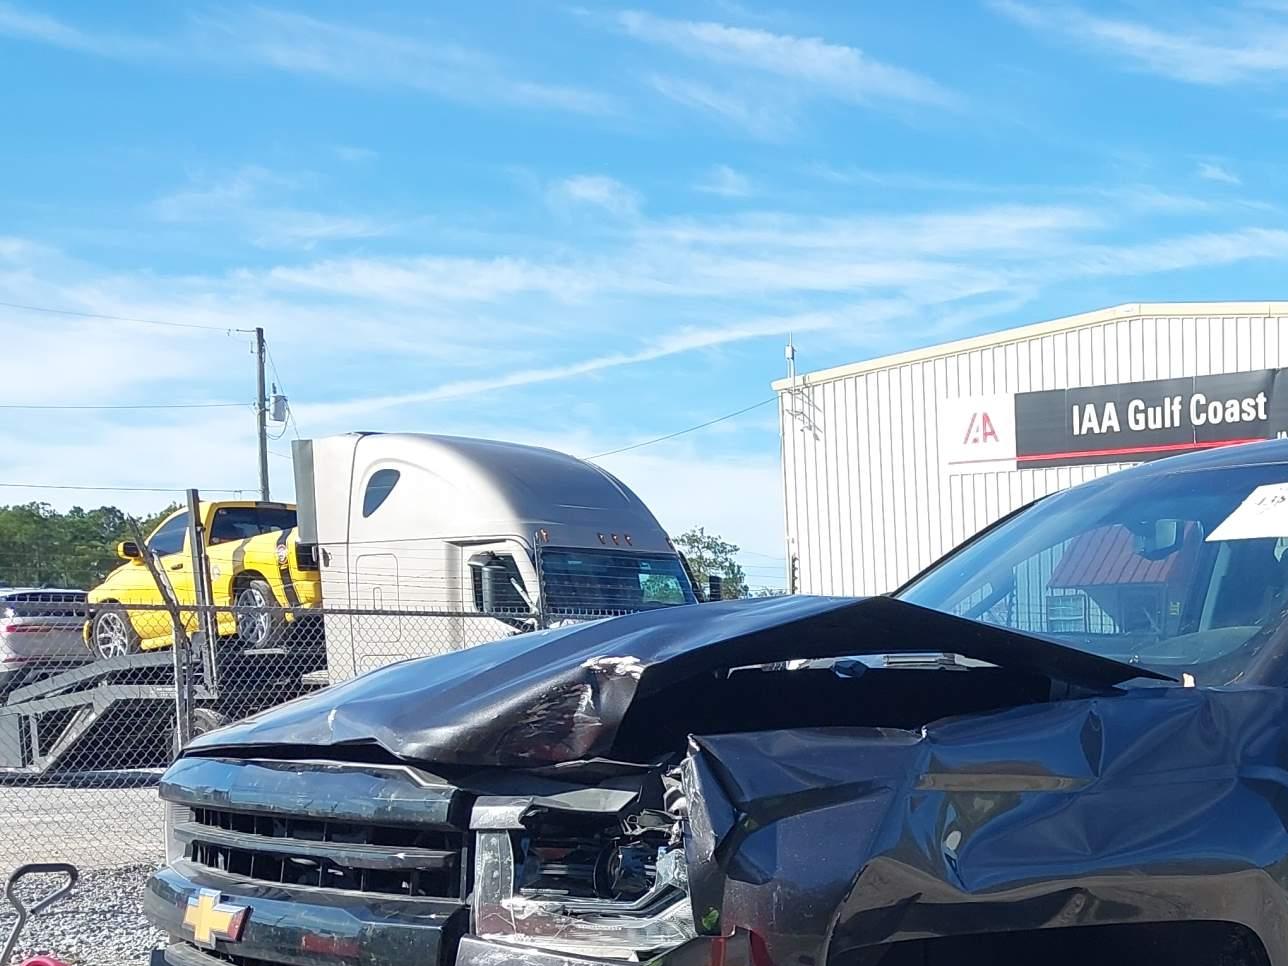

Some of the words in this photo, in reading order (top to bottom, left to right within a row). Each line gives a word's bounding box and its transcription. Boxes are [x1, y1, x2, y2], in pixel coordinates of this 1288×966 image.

[1071, 402, 1120, 436] IAA
[1127, 394, 1182, 432] Gulf
[1190, 391, 1268, 427] Coast
